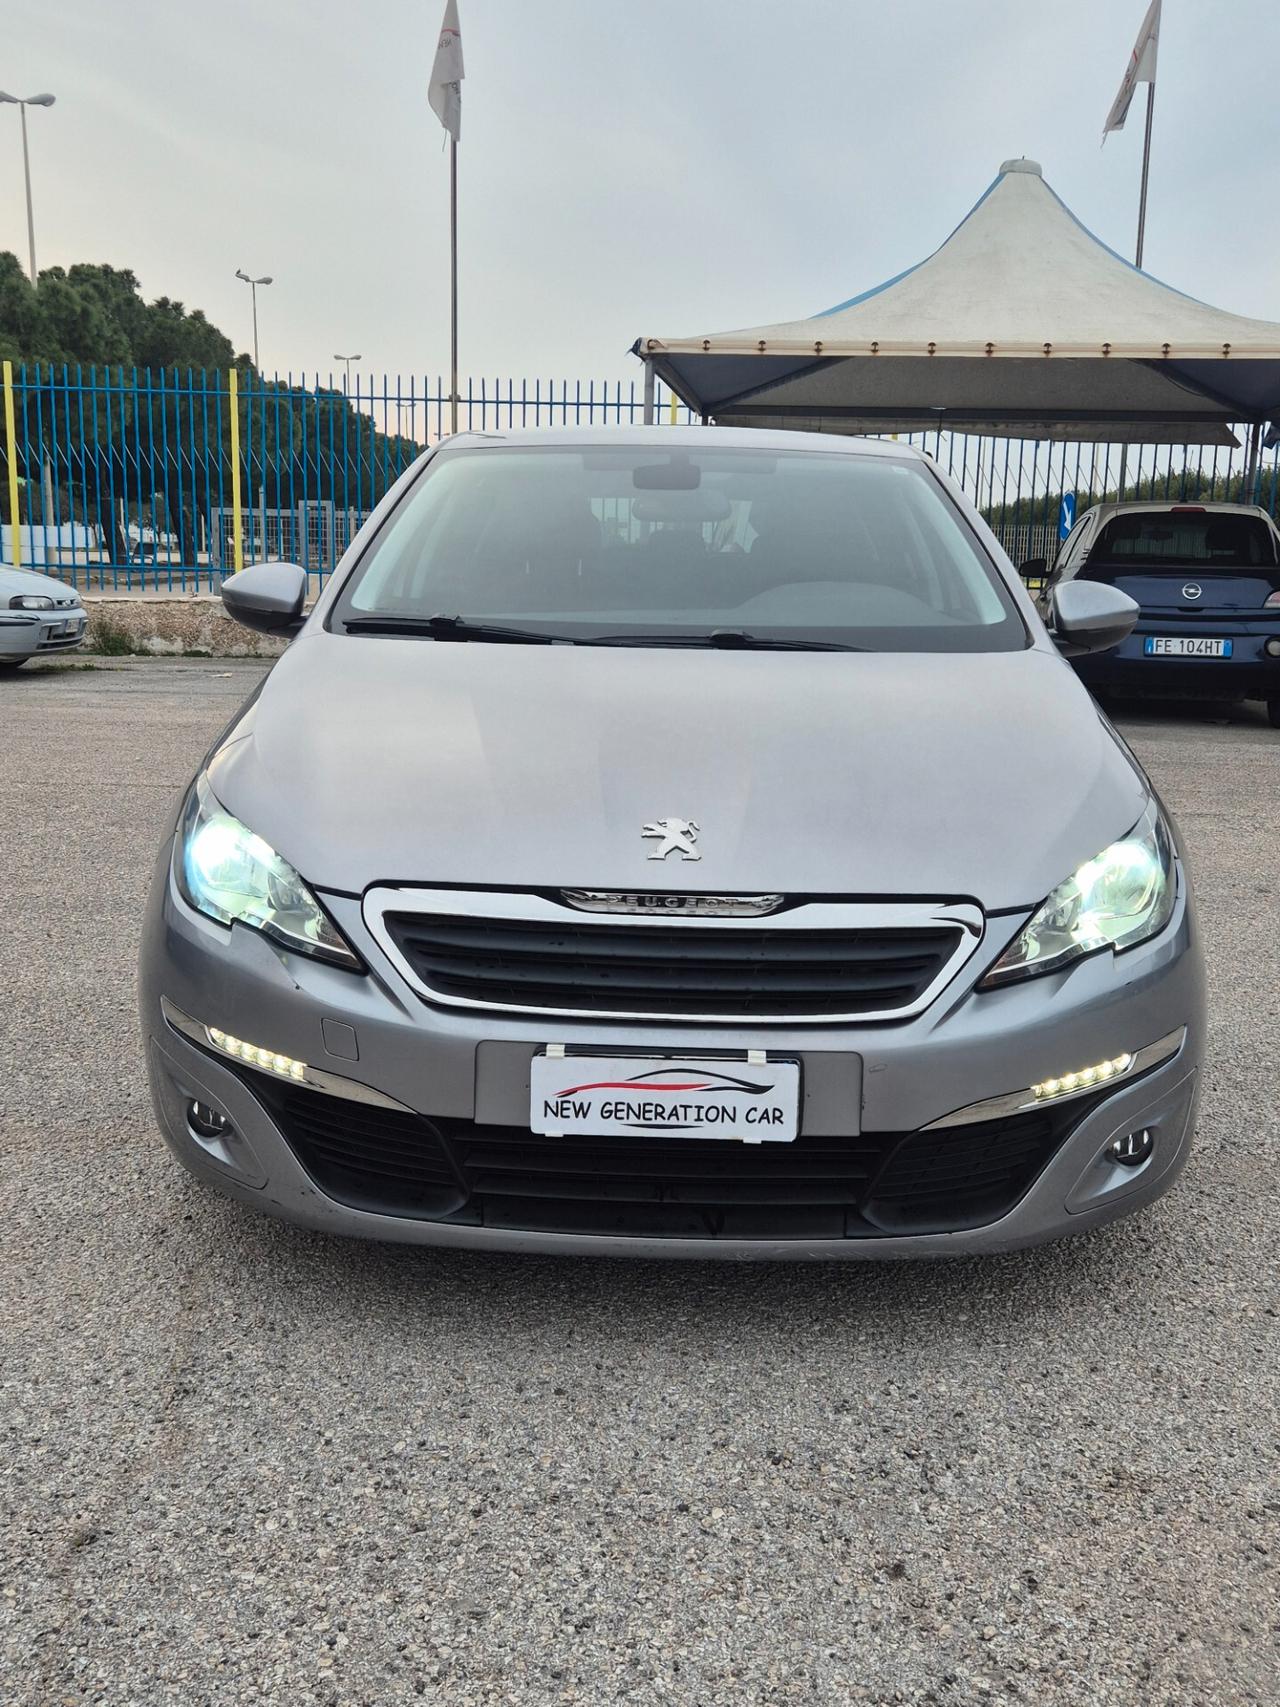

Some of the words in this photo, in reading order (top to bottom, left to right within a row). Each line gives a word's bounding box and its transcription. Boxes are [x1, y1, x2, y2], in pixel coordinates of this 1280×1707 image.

[1155, 639, 1172, 653] FE
[1179, 640, 1222, 654] 104HT
[608, 894, 739, 909] PEUGEOT
[543, 1100, 592, 1119] NEW
[600, 1101, 737, 1124] GENERATION
[745, 1107, 784, 1125] CAR
